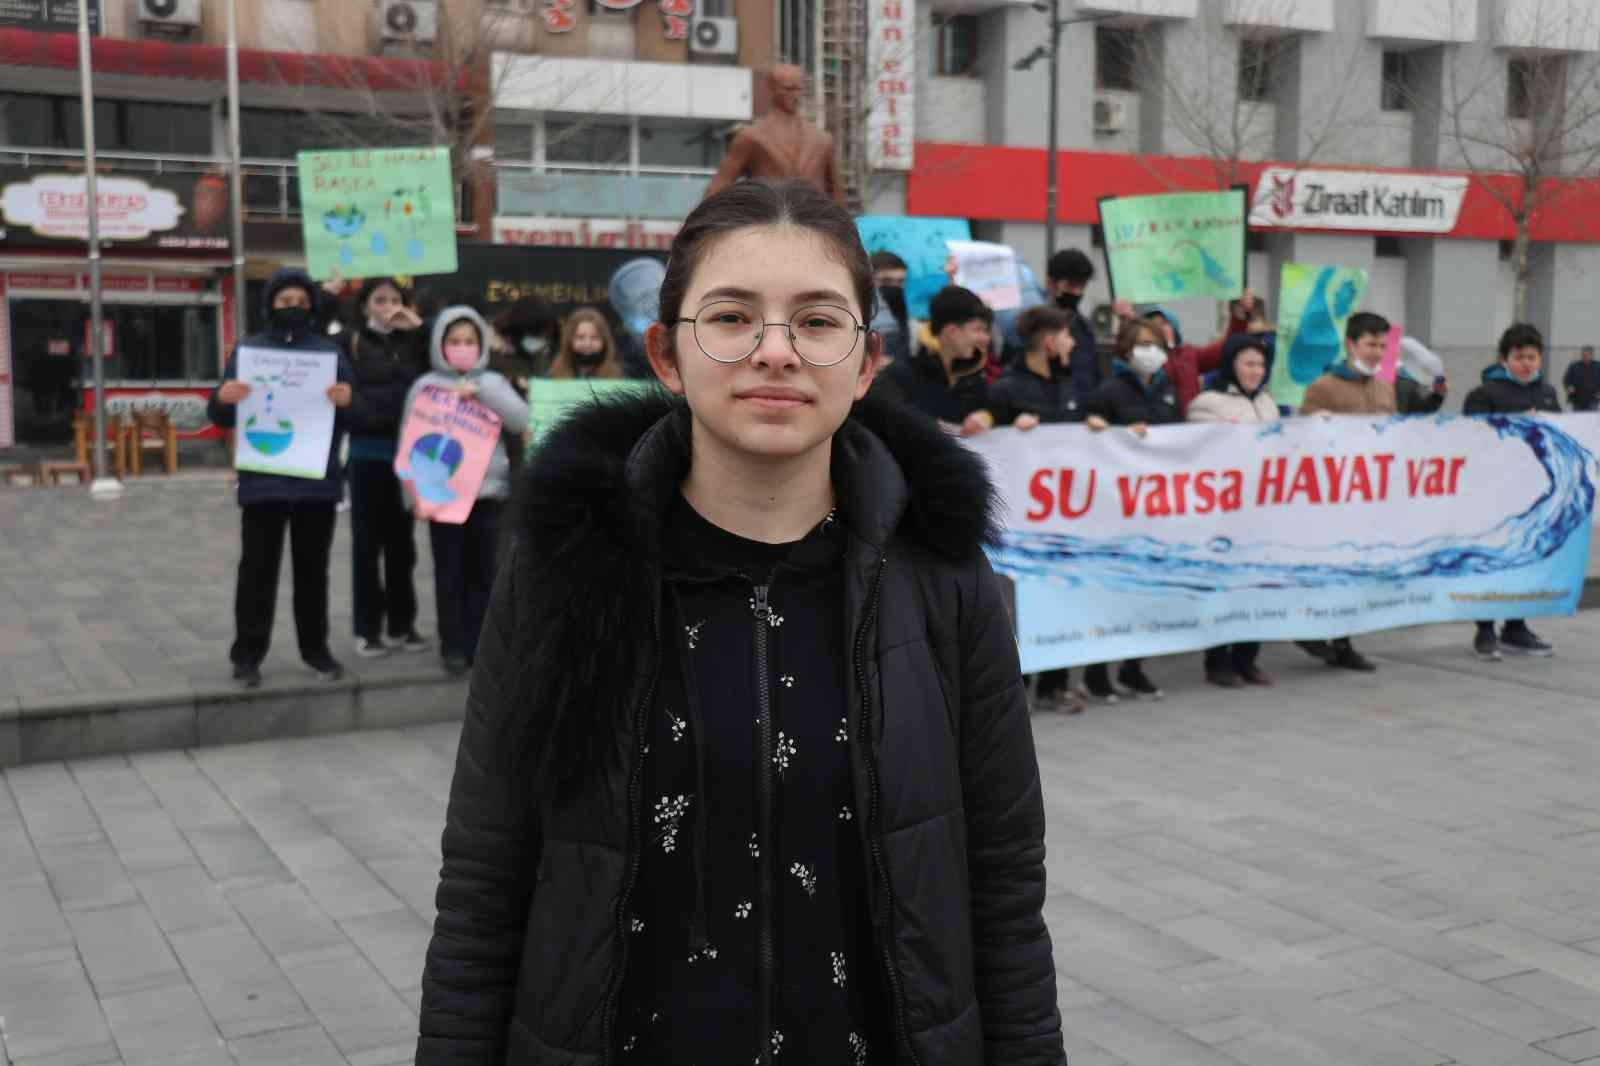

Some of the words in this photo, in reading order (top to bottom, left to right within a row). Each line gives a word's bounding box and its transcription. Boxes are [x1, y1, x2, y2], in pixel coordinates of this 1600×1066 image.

[1304, 184, 1369, 216] Ziraat
[1373, 187, 1445, 219] Katılım
[1026, 467, 1096, 522] SU
[1117, 468, 1243, 518] varsa
[1256, 453, 1395, 507] HAYAT
[1405, 456, 1466, 499] var
